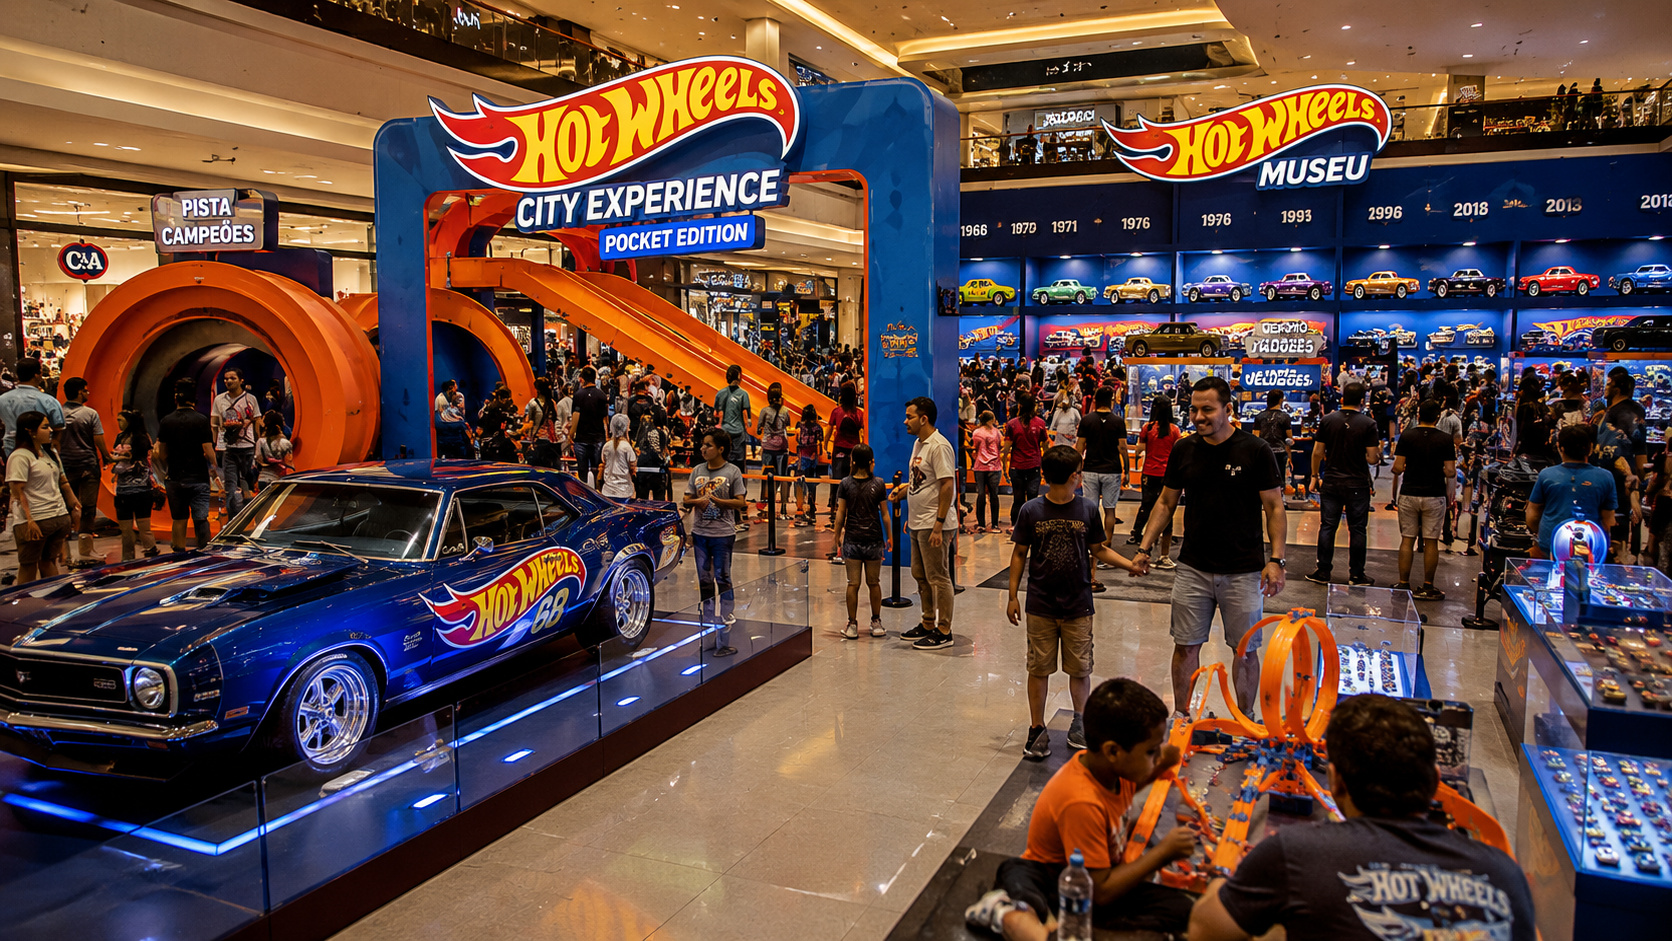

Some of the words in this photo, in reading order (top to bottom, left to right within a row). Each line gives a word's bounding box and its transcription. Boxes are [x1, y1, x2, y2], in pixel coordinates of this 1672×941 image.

[504, 104, 612, 183] HOT
[1163, 120, 1249, 176] HOT
[1258, 154, 1369, 187] MUSEU
[182, 197, 232, 217] PISTA
[517, 191, 582, 228] CITY
[586, 168, 781, 221] EXPERIENCE
[1545, 198, 1583, 213] 2013
[1280, 209, 1312, 224] 1993
[1368, 205, 1403, 220] 2996
[1453, 201, 1489, 217] 2018
[1051, 219, 1078, 233] 1971
[1121, 216, 1151, 230] 1976
[1201, 212, 1232, 227] 1976
[605, 227, 670, 253] POCKET
[676, 222, 749, 247] EDITION
[960, 223, 988, 237] 1966
[469, 582, 520, 641] HOT
[530, 587, 569, 635] 68
[1368, 869, 1420, 902] HOT
[1418, 867, 1511, 917] WHEELS
